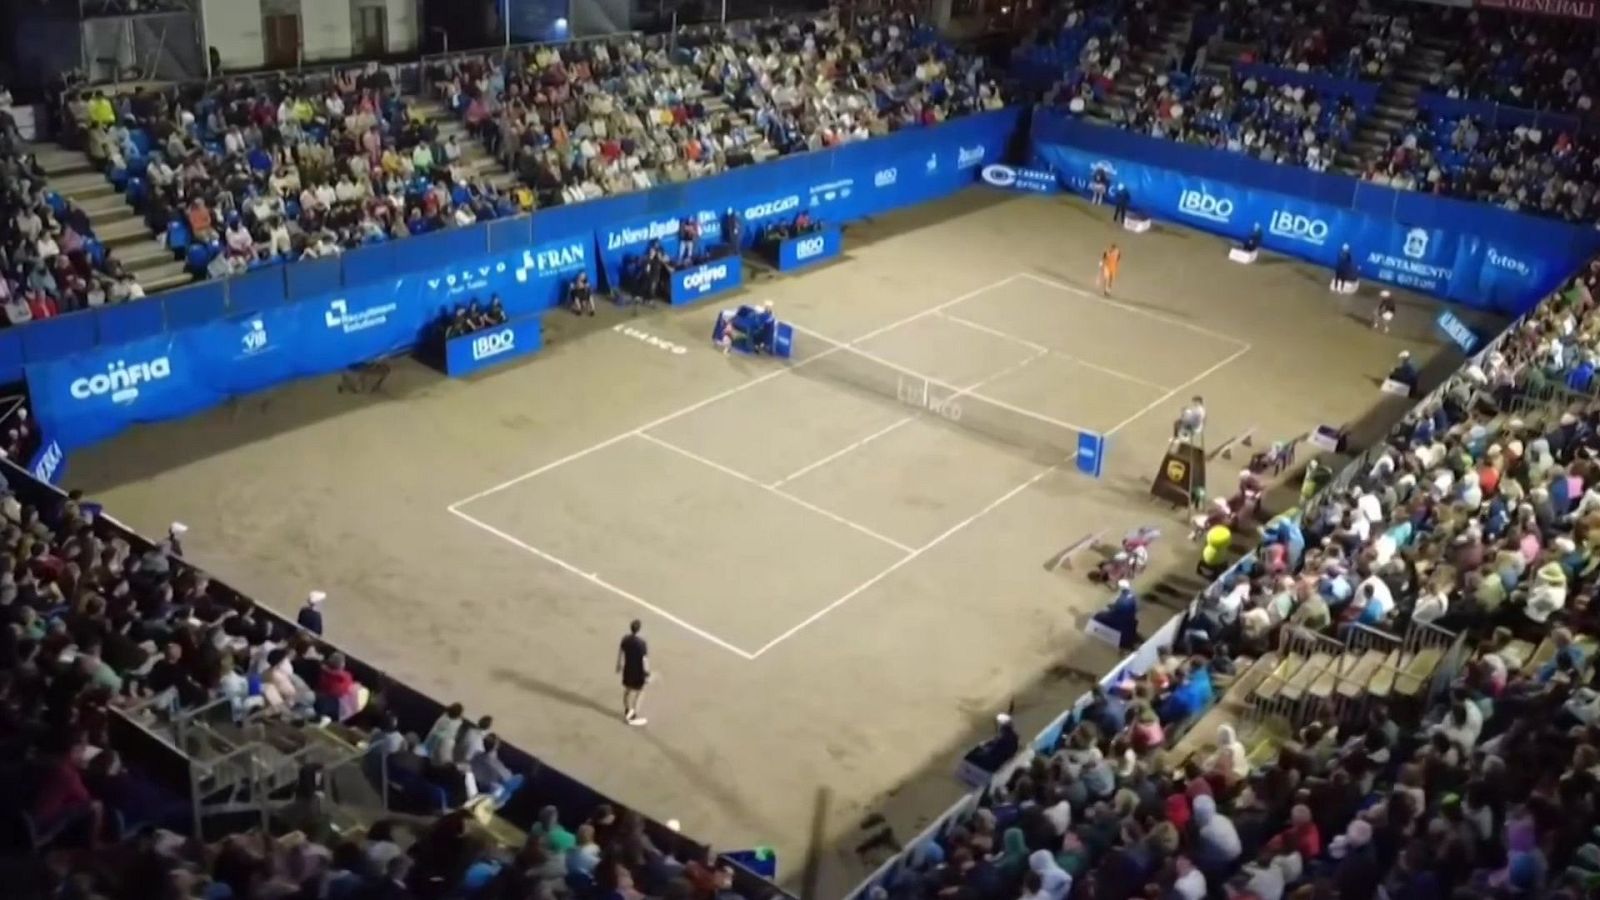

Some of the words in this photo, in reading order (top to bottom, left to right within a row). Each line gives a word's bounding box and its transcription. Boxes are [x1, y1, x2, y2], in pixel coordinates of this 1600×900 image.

[1179, 190, 1233, 223] BDO
[1270, 210, 1329, 245] BDO
[537, 243, 585, 270] FRAN
[427, 262, 506, 289] VOLVO
[472, 328, 515, 361] BDO
